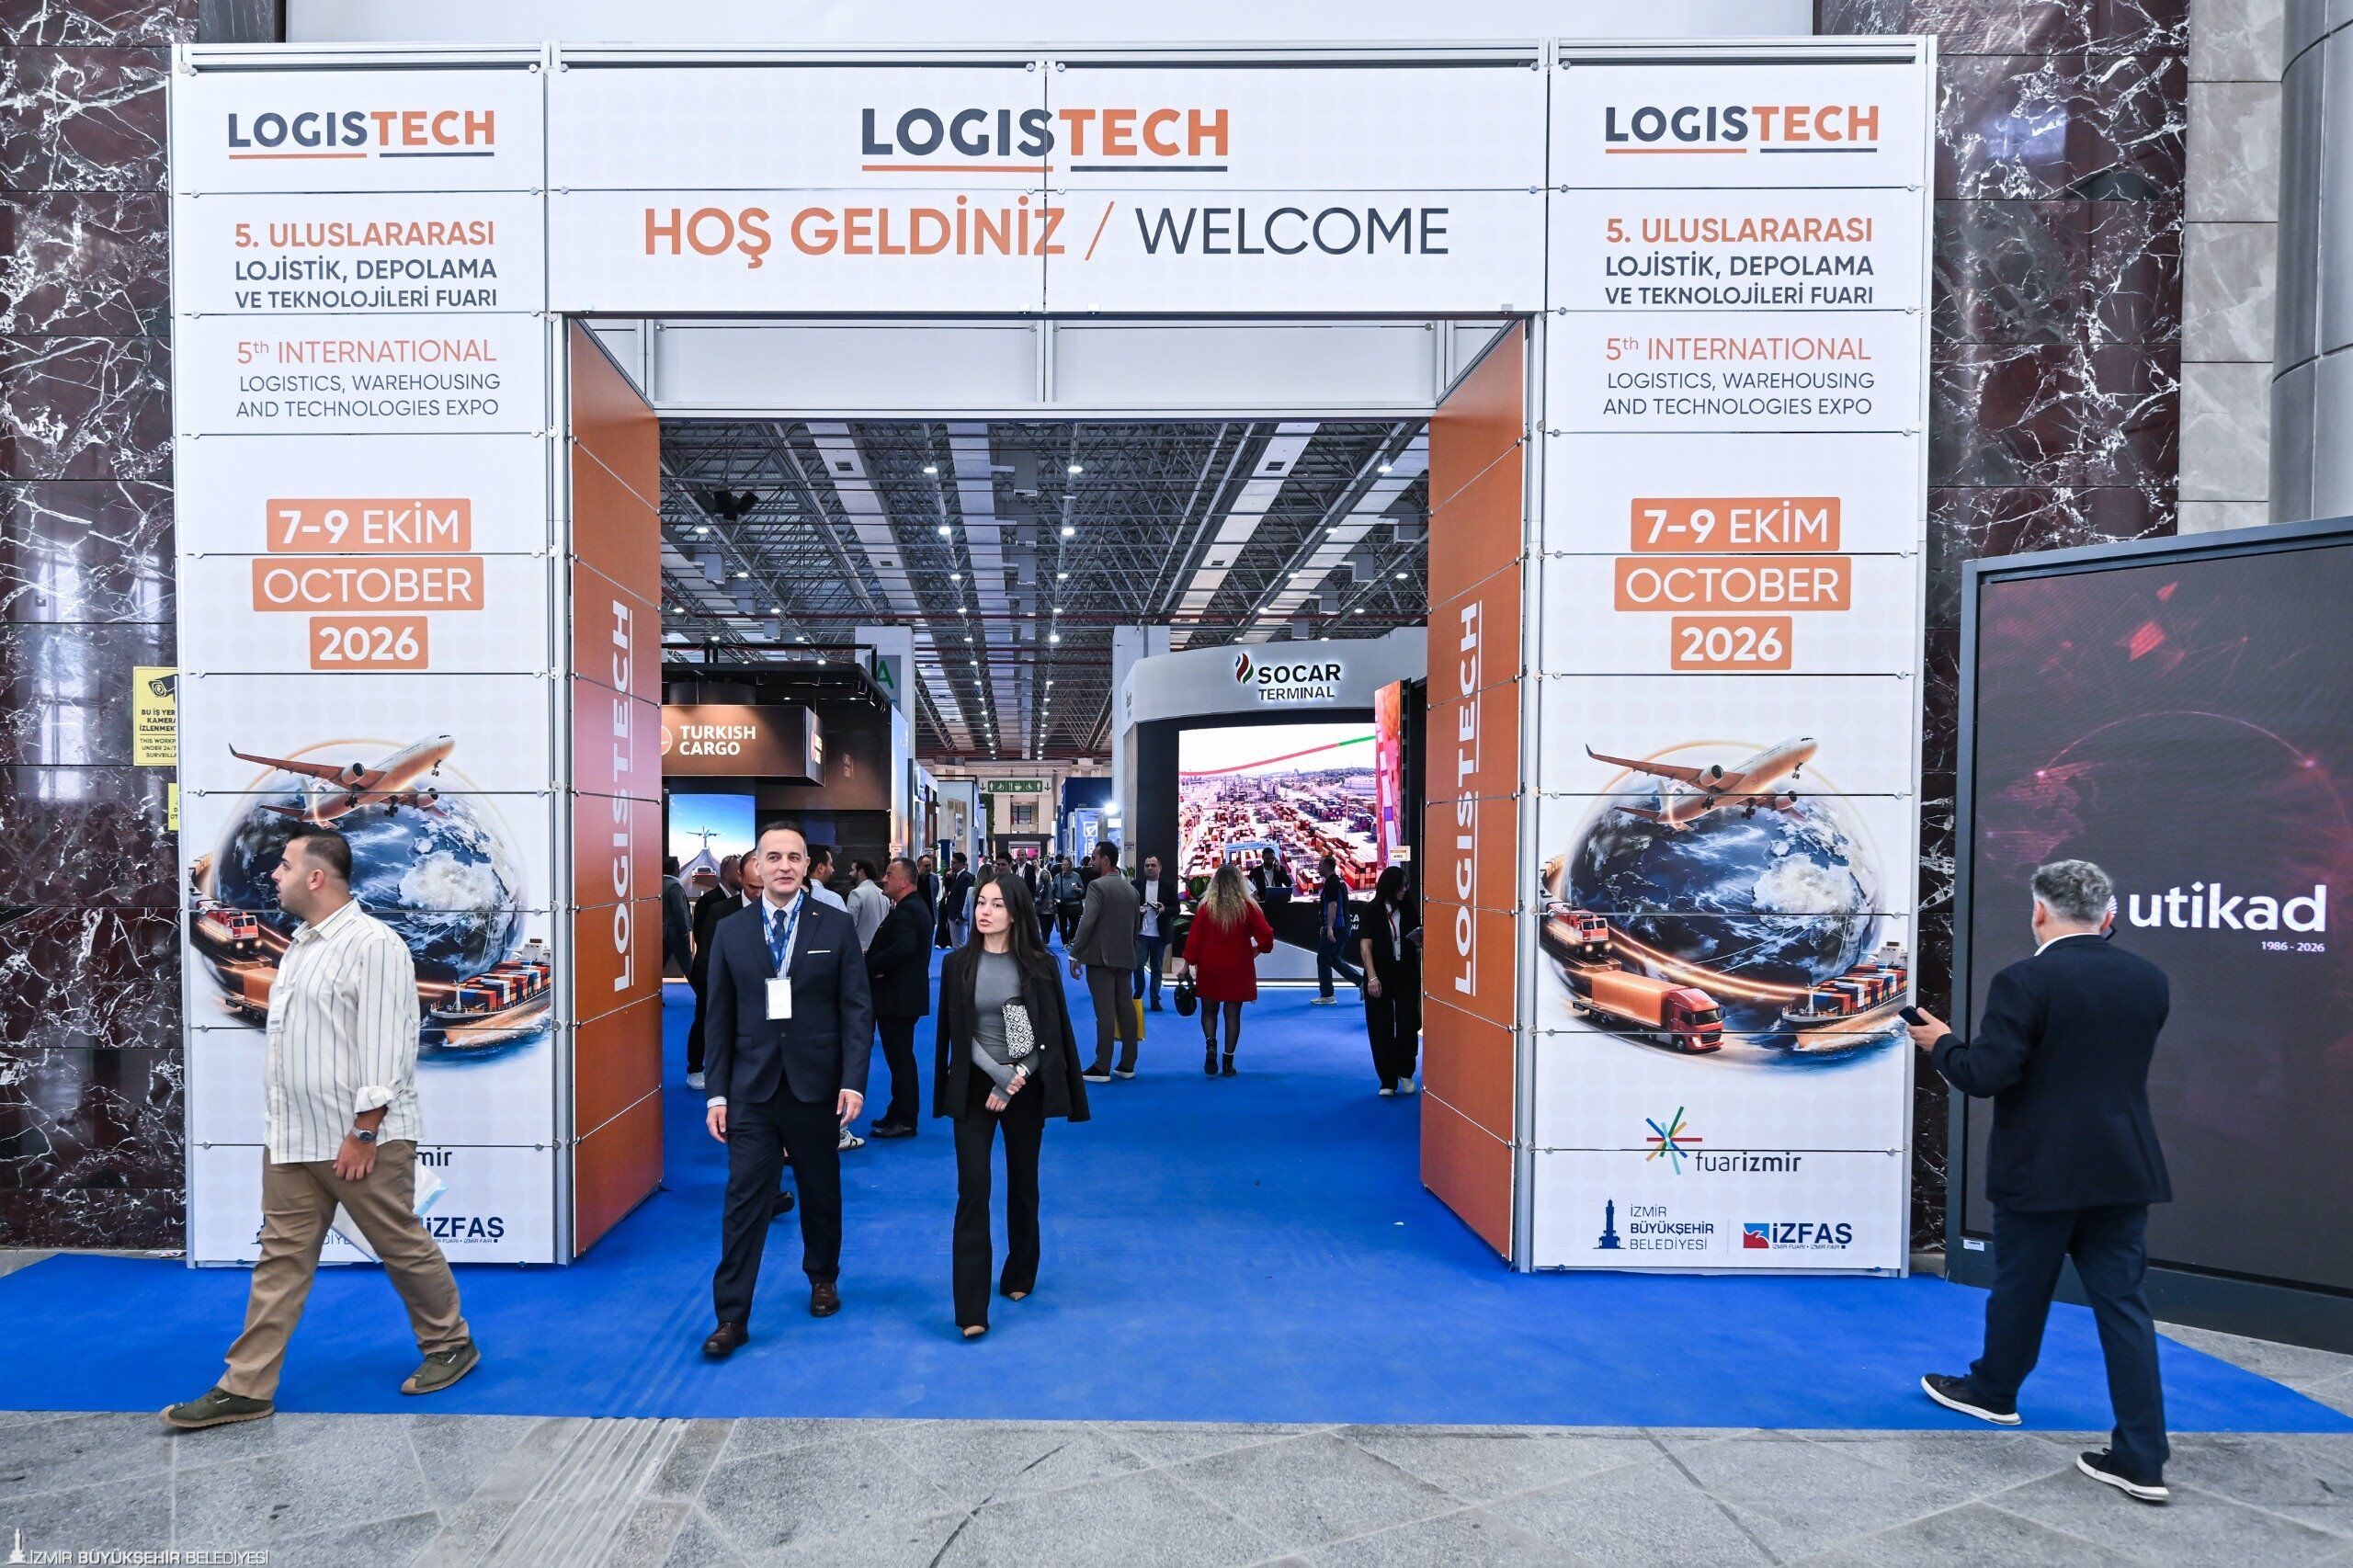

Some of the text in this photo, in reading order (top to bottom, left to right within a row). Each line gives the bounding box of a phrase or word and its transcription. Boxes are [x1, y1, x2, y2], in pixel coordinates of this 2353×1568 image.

[228, 110, 494, 148] LOGISTECH
[861, 108, 1229, 158] LOGISTECH
[1605, 105, 1879, 142] LOGISTECH
[234, 221, 494, 249] 5. ULUSLARARASI
[644, 206, 773, 270] HOŞ
[789, 193, 1066, 256] GELDİNİZ
[1134, 207, 1449, 256] WELCOME
[1606, 217, 1872, 244] 5. ULUSLARARASI
[235, 255, 498, 283] LOJİSTİK, DEPOLAMA
[1605, 250, 1874, 280] LOJİSTİK, DEPOLAMA
[235, 285, 497, 308] VE TEKNOLOJİLERİ FUARI
[1605, 281, 1873, 305] VE TEKNOLOJİLERİ FUARI
[237, 339, 497, 365] 5th INTERNATIONAL
[1606, 336, 1871, 361] 5th INTERNATIONAL
[239, 372, 501, 393] LOGISTICS, WAREHOUSING
[1607, 371, 1875, 392] LOGISTICS, WAREHOUSING
[235, 399, 499, 418] AND TECHNOLOGIES EXPO
[1603, 398, 1872, 415] AND TECHNOLOGIES EXPO
[363, 501, 459, 544] EKİM
[1730, 500, 1827, 543] EKİM
[264, 568, 472, 603] OCTOBER
[1626, 567, 1839, 603] OCTOBER
[319, 626, 419, 662] 2026
[1680, 626, 1783, 662] 2026
[1257, 664, 1341, 684] SOCAR
[1258, 686, 1336, 701] TERMINAL
[680, 725, 756, 740] TURKISH
[679, 741, 741, 756] CARGO
[612, 599, 629, 992] LOGISTECH
[1455, 602, 1478, 995] LOGISTECH
[2128, 881, 2327, 932] utikad
[2260, 940, 2289, 951] 1986
[2296, 942, 2325, 952] 2026
[1696, 1152, 1802, 1172] fuarizmir
[1630, 1203, 1666, 1217] İZMİR
[1631, 1220, 1714, 1235] BÜYÜKŞEHİR
[1630, 1236, 1708, 1250] BELEDİYESİ
